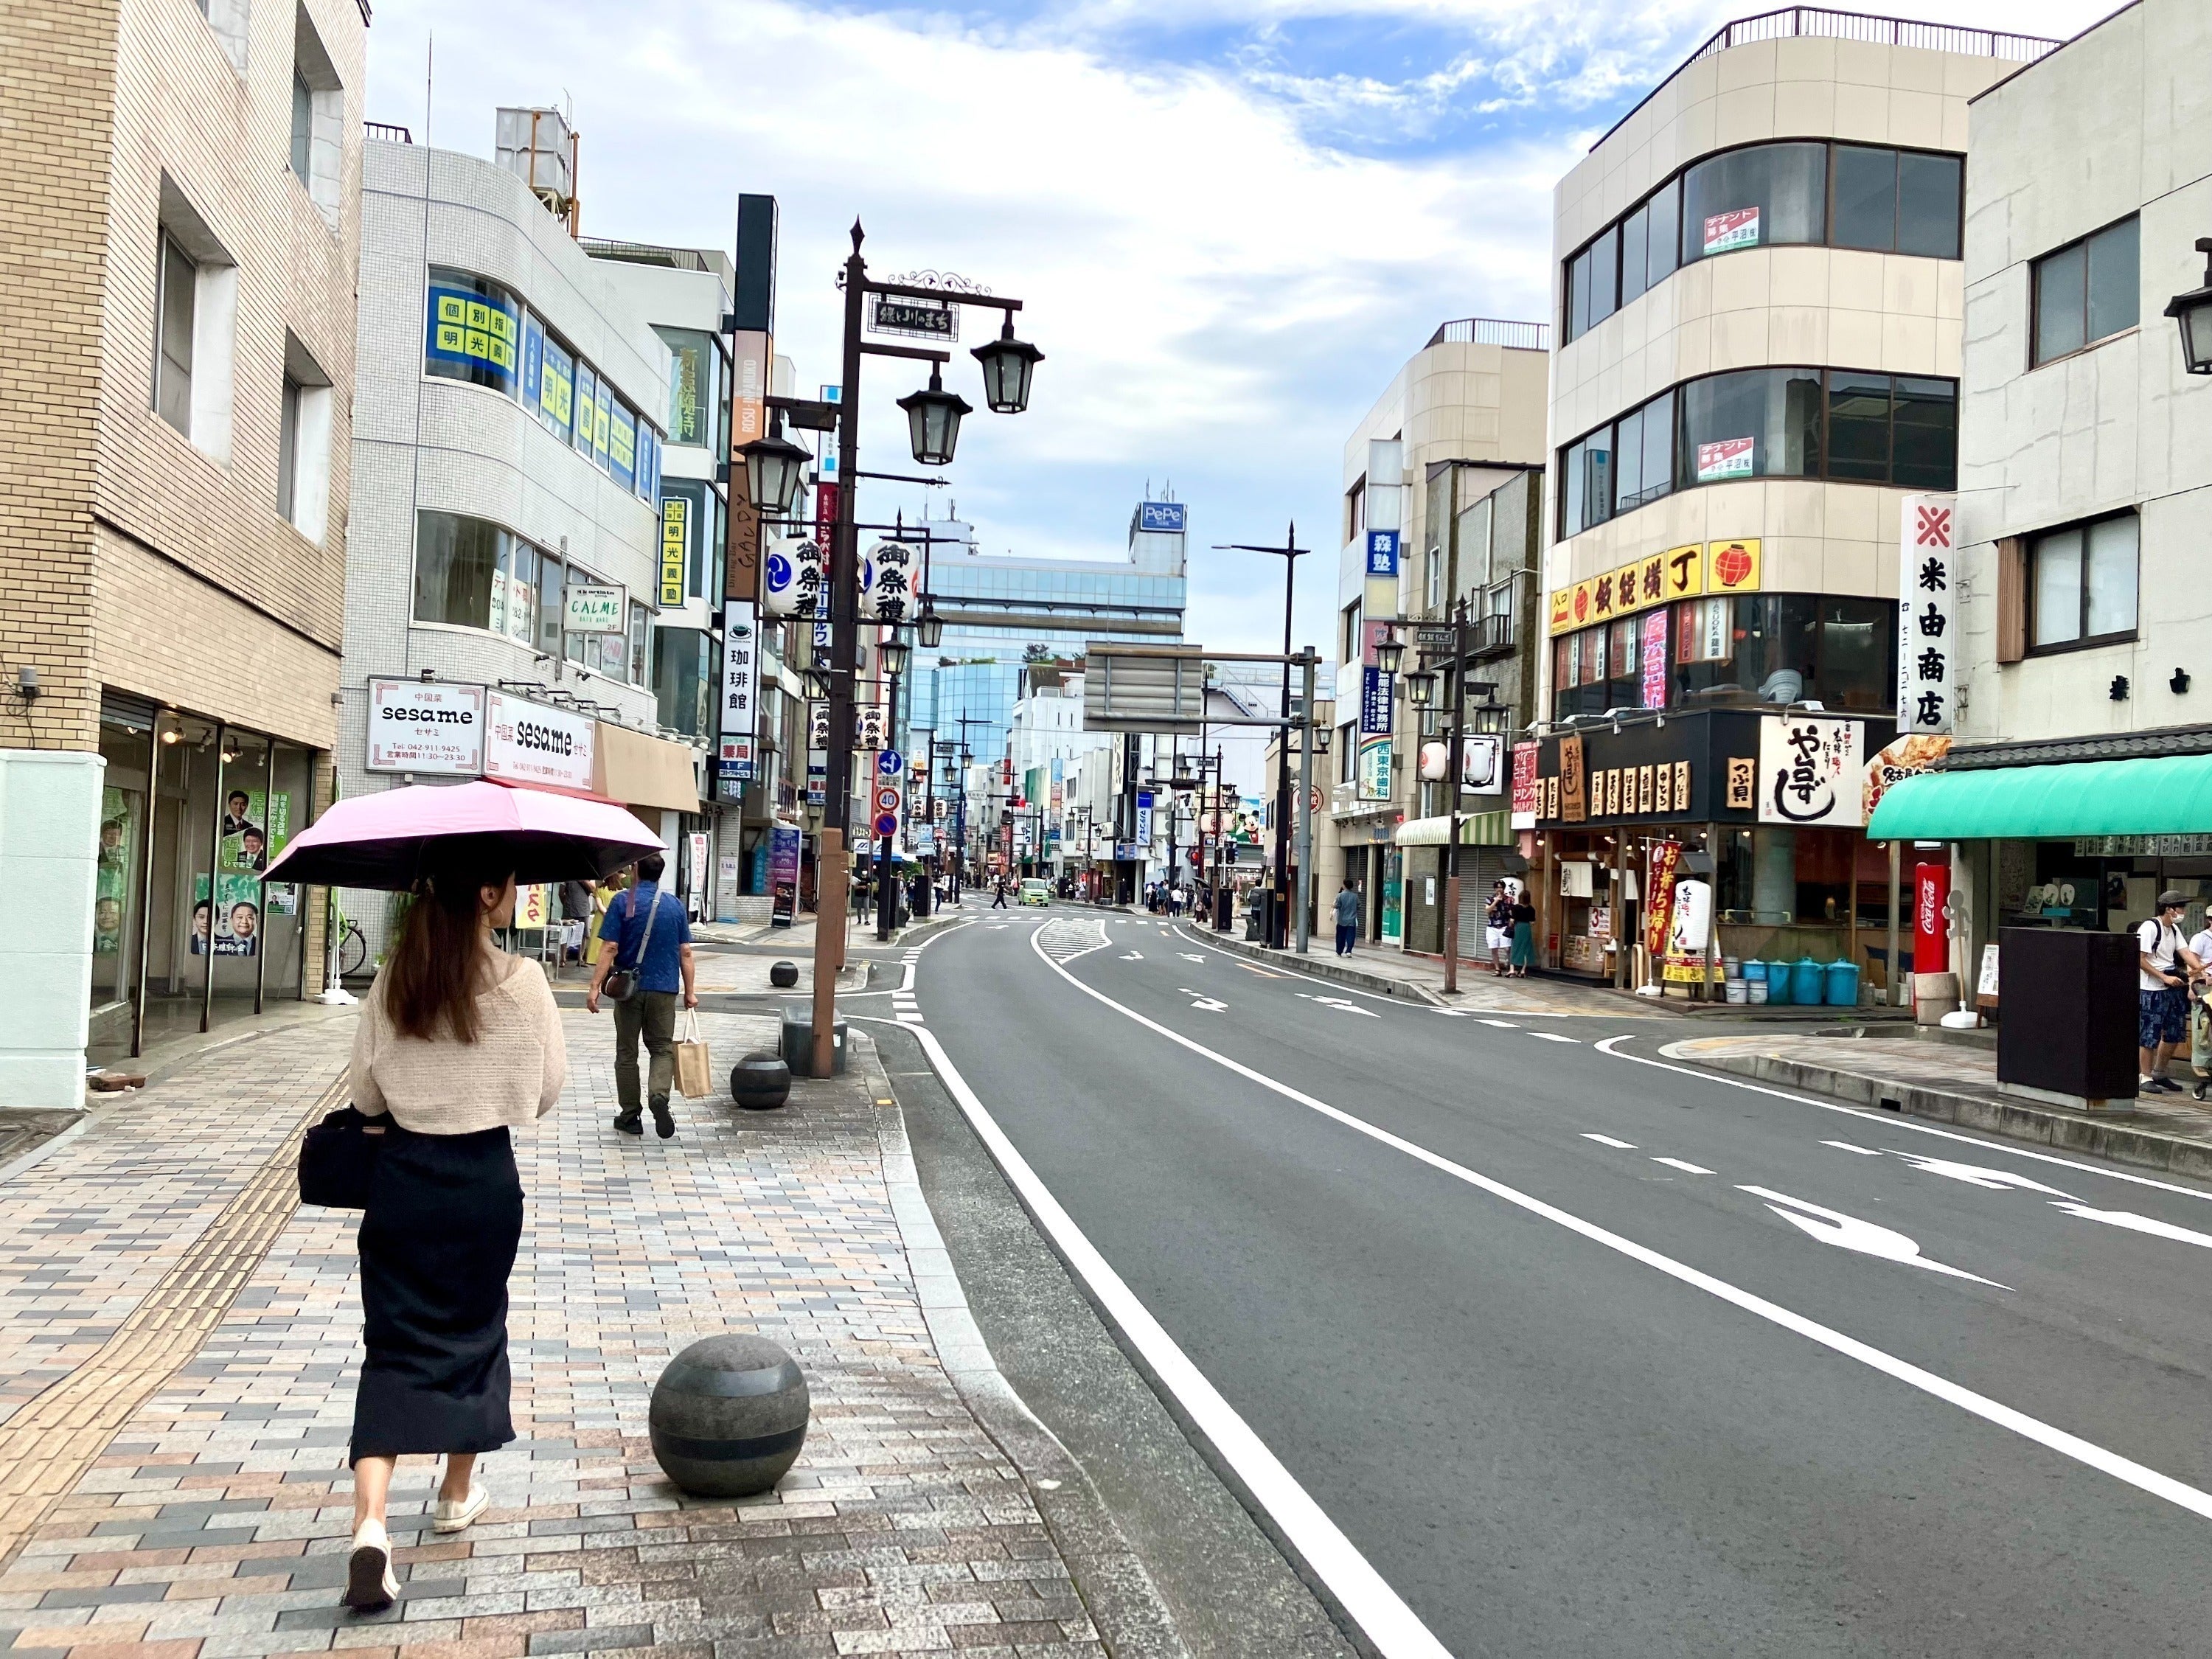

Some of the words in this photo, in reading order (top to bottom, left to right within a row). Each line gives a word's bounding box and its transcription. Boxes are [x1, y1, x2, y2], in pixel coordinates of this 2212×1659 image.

[1707, 211, 1751, 227] テナント
[1701, 441, 1747, 454] テナント
[1145, 507, 1180, 521] PePe
[666, 526, 679, 599] 明光義塾
[1373, 535, 1391, 571] 森塾
[1595, 550, 1697, 616] 飯能横丁
[571, 600, 619, 615] CALME
[1553, 593, 1567, 608] 入口
[813, 582, 829, 667] エーデルワス
[1916, 557, 1947, 726] 米由商店
[729, 650, 748, 709] 珈琲館
[414, 692, 442, 703] 中国菜
[382, 706, 473, 724] sesame
[414, 727, 439, 737] セサミ
[517, 720, 572, 757] sesame
[723, 745, 748, 759] 薬局
[1376, 744, 1390, 798] 西東京歯科
[1733, 763, 1749, 802] つぶ貝
[881, 794, 894, 805] 40
[1649, 846, 1677, 950] お持ち帰り
[1921, 877, 1935, 935] Coca-Cola
[1592, 908, 1599, 928] 3
